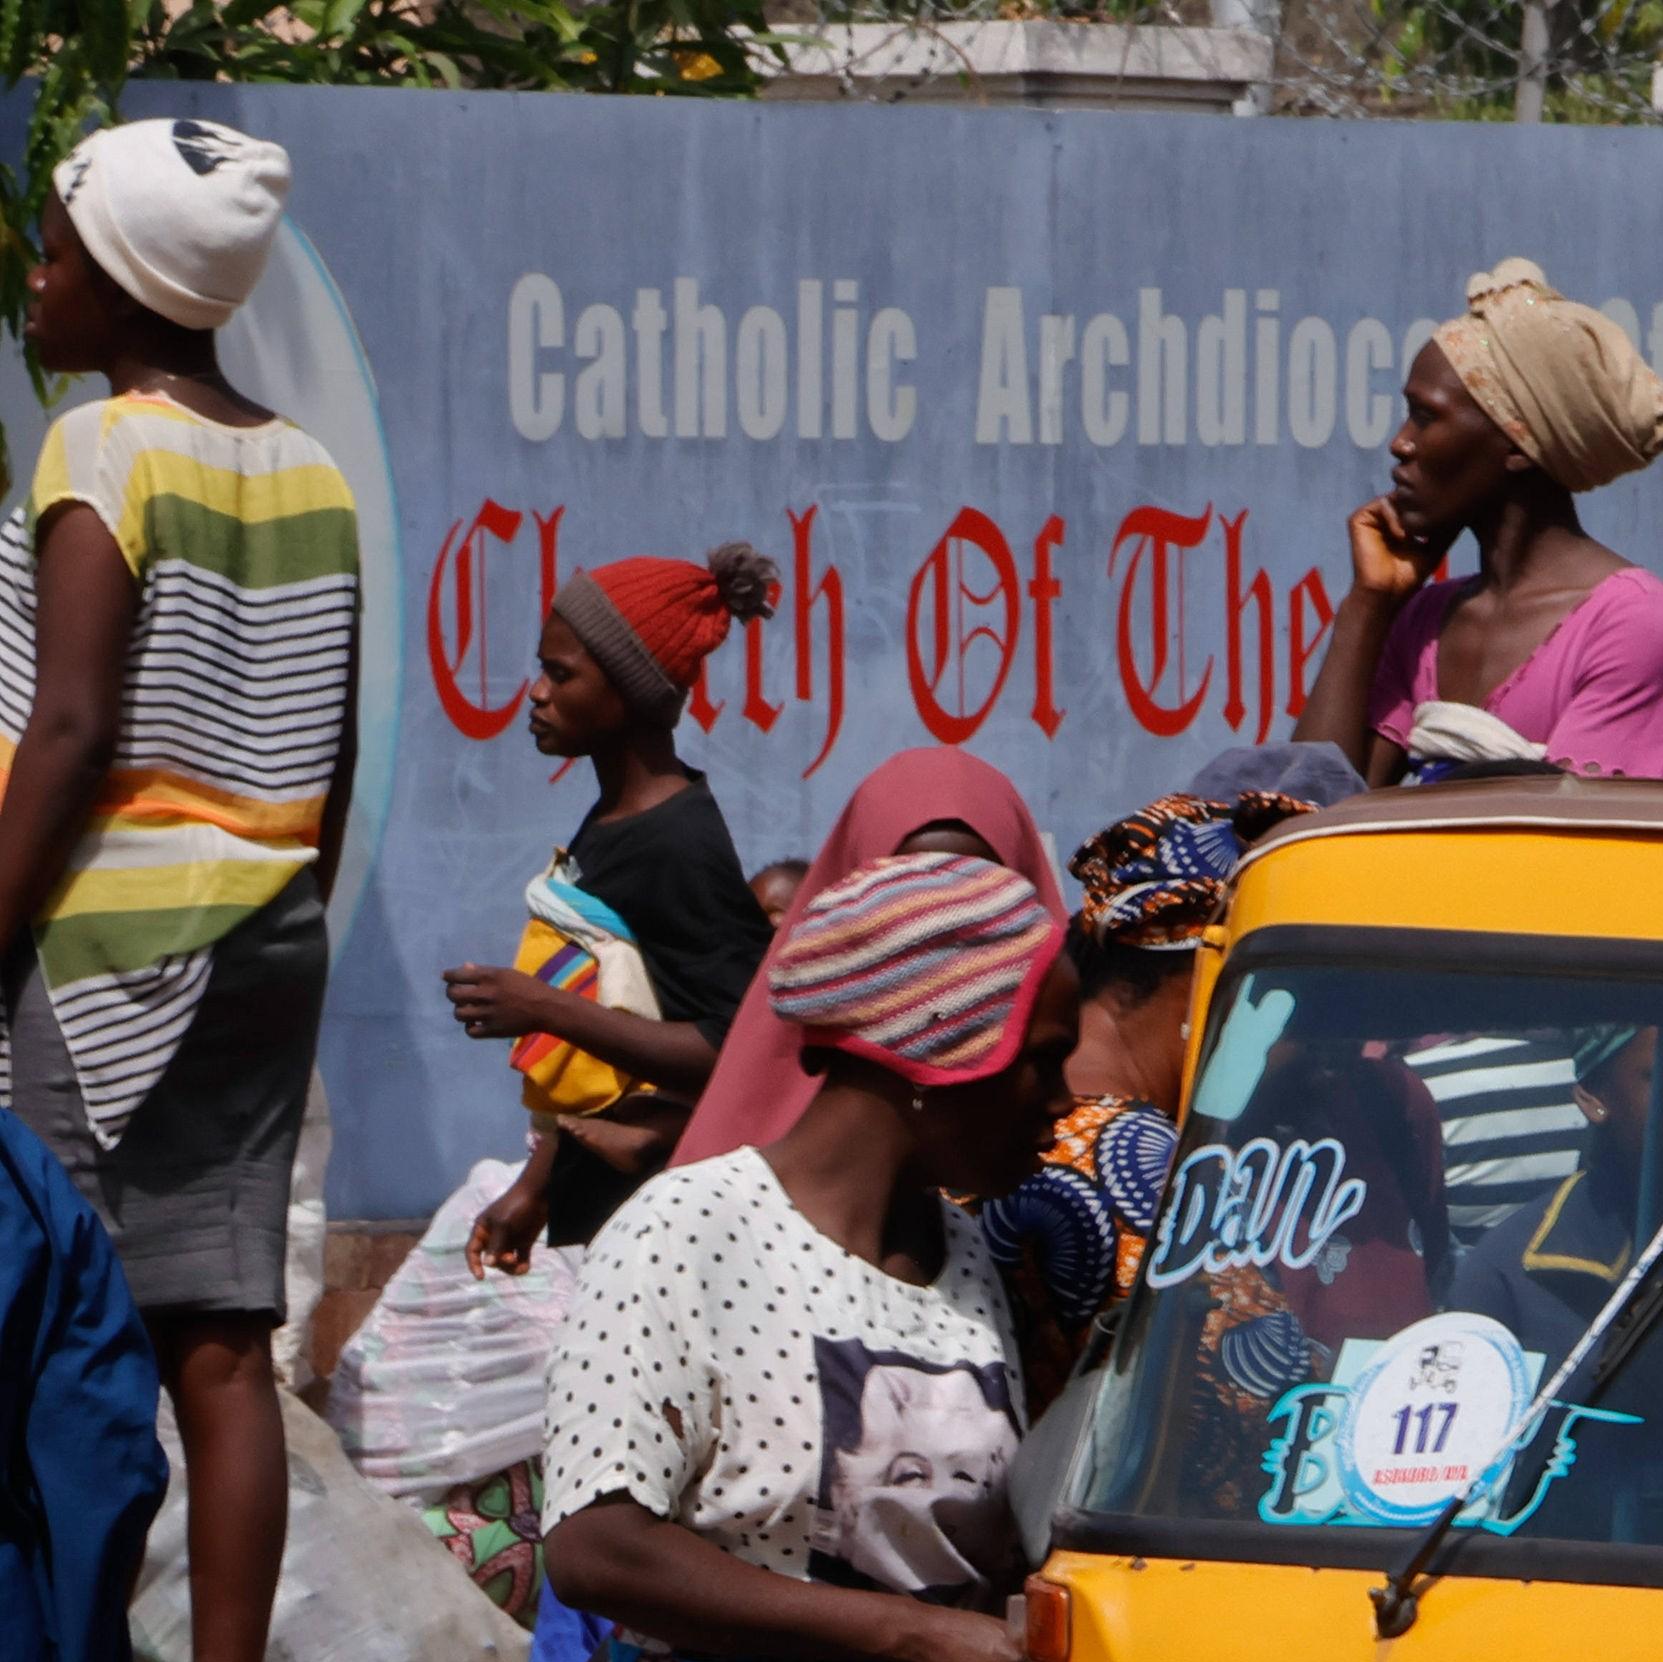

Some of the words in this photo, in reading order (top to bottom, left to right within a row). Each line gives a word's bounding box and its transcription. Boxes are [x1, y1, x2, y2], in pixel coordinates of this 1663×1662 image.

[507, 272, 918, 442] Catholic
[975, 286, 1438, 450] Archdioc
[427, 497, 846, 784] Cch
[905, 505, 1067, 746] Of
[1107, 500, 1337, 748] The
[1391, 1402, 1459, 1455] 117
